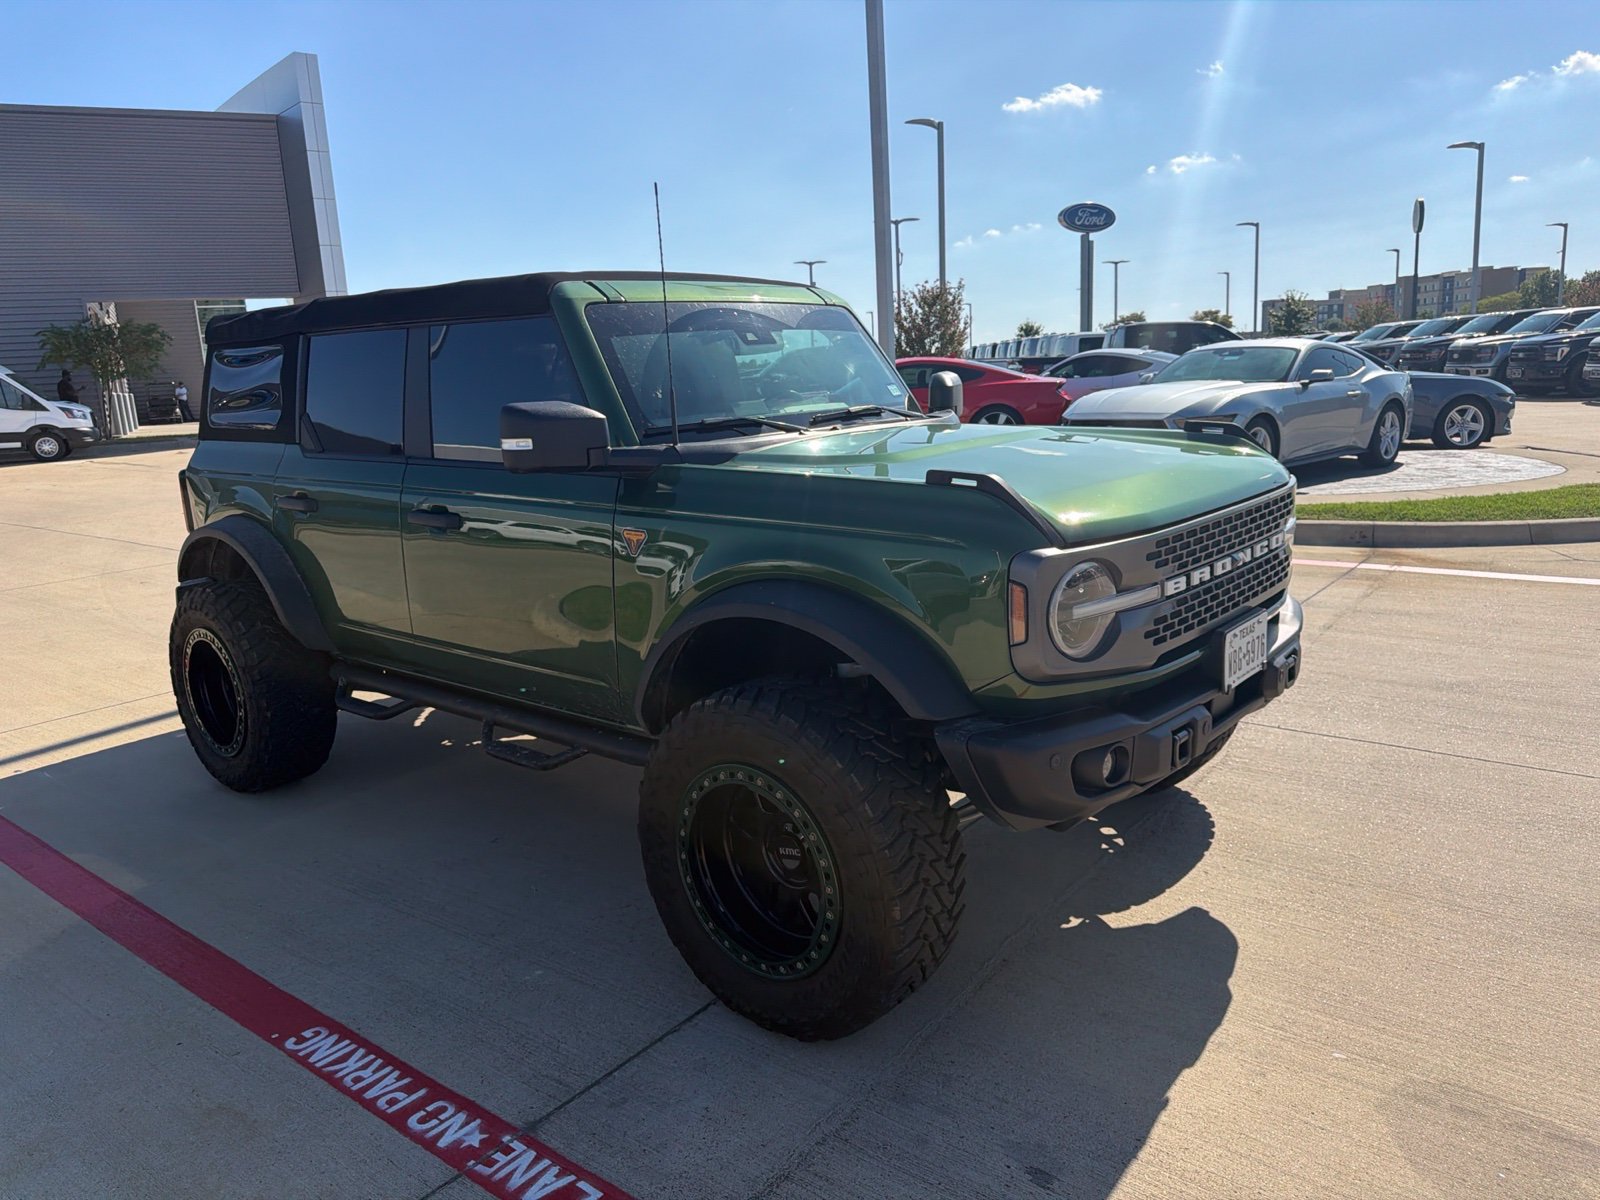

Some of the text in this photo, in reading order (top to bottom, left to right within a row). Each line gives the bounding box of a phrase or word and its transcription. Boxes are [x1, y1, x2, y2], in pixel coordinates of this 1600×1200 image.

[1075, 207, 1106, 226] Ford
[1164, 531, 1284, 597] BRONCO
[1239, 622, 1256, 641] TEXAS
[779, 847, 801, 857] KMC
[284, 1026, 428, 1114] PARKING
[406, 1100, 481, 1149] NO
